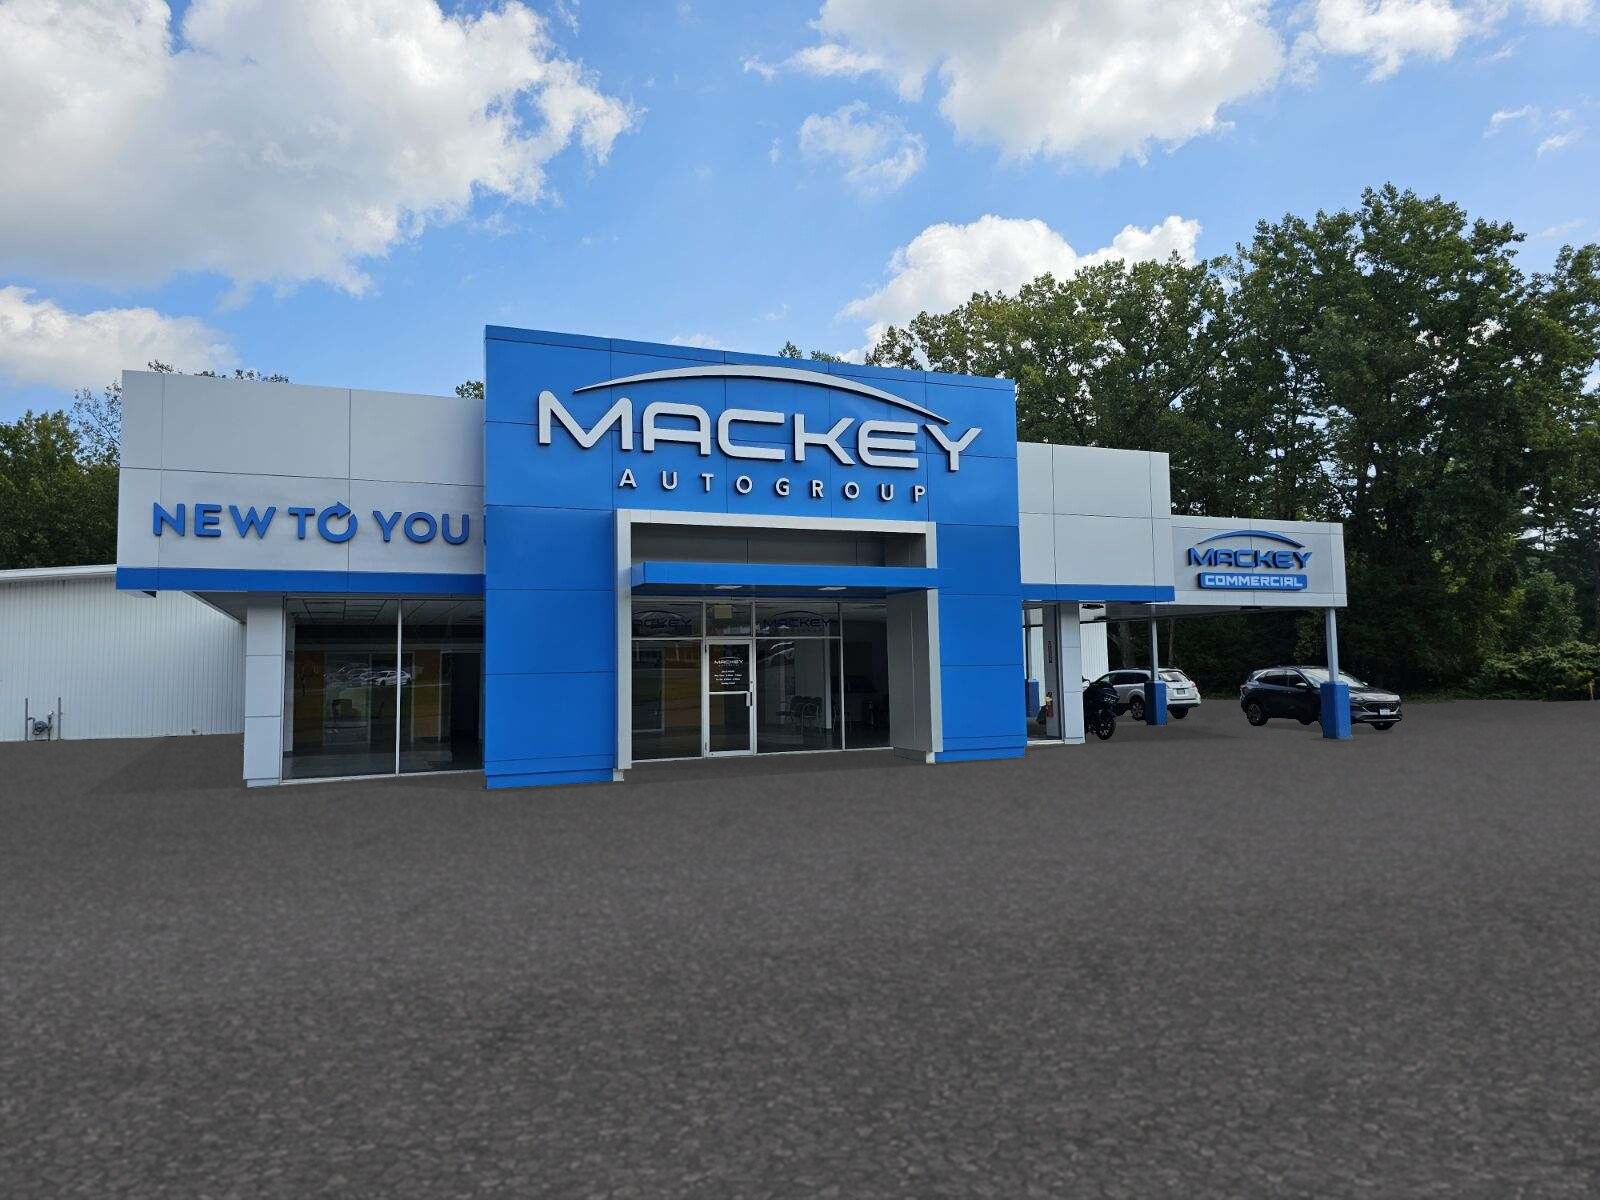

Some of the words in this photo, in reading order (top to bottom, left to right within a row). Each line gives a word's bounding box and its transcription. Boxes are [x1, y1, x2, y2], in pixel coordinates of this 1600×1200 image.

[538, 389, 983, 472] MACKEY
[619, 468, 926, 503] AUTOGROUP
[152, 502, 277, 539] NEW
[288, 502, 358, 543] TO
[372, 510, 471, 545] YOU
[1187, 547, 1313, 569] MACKEY
[1204, 574, 1304, 587] COMMERCIAL
